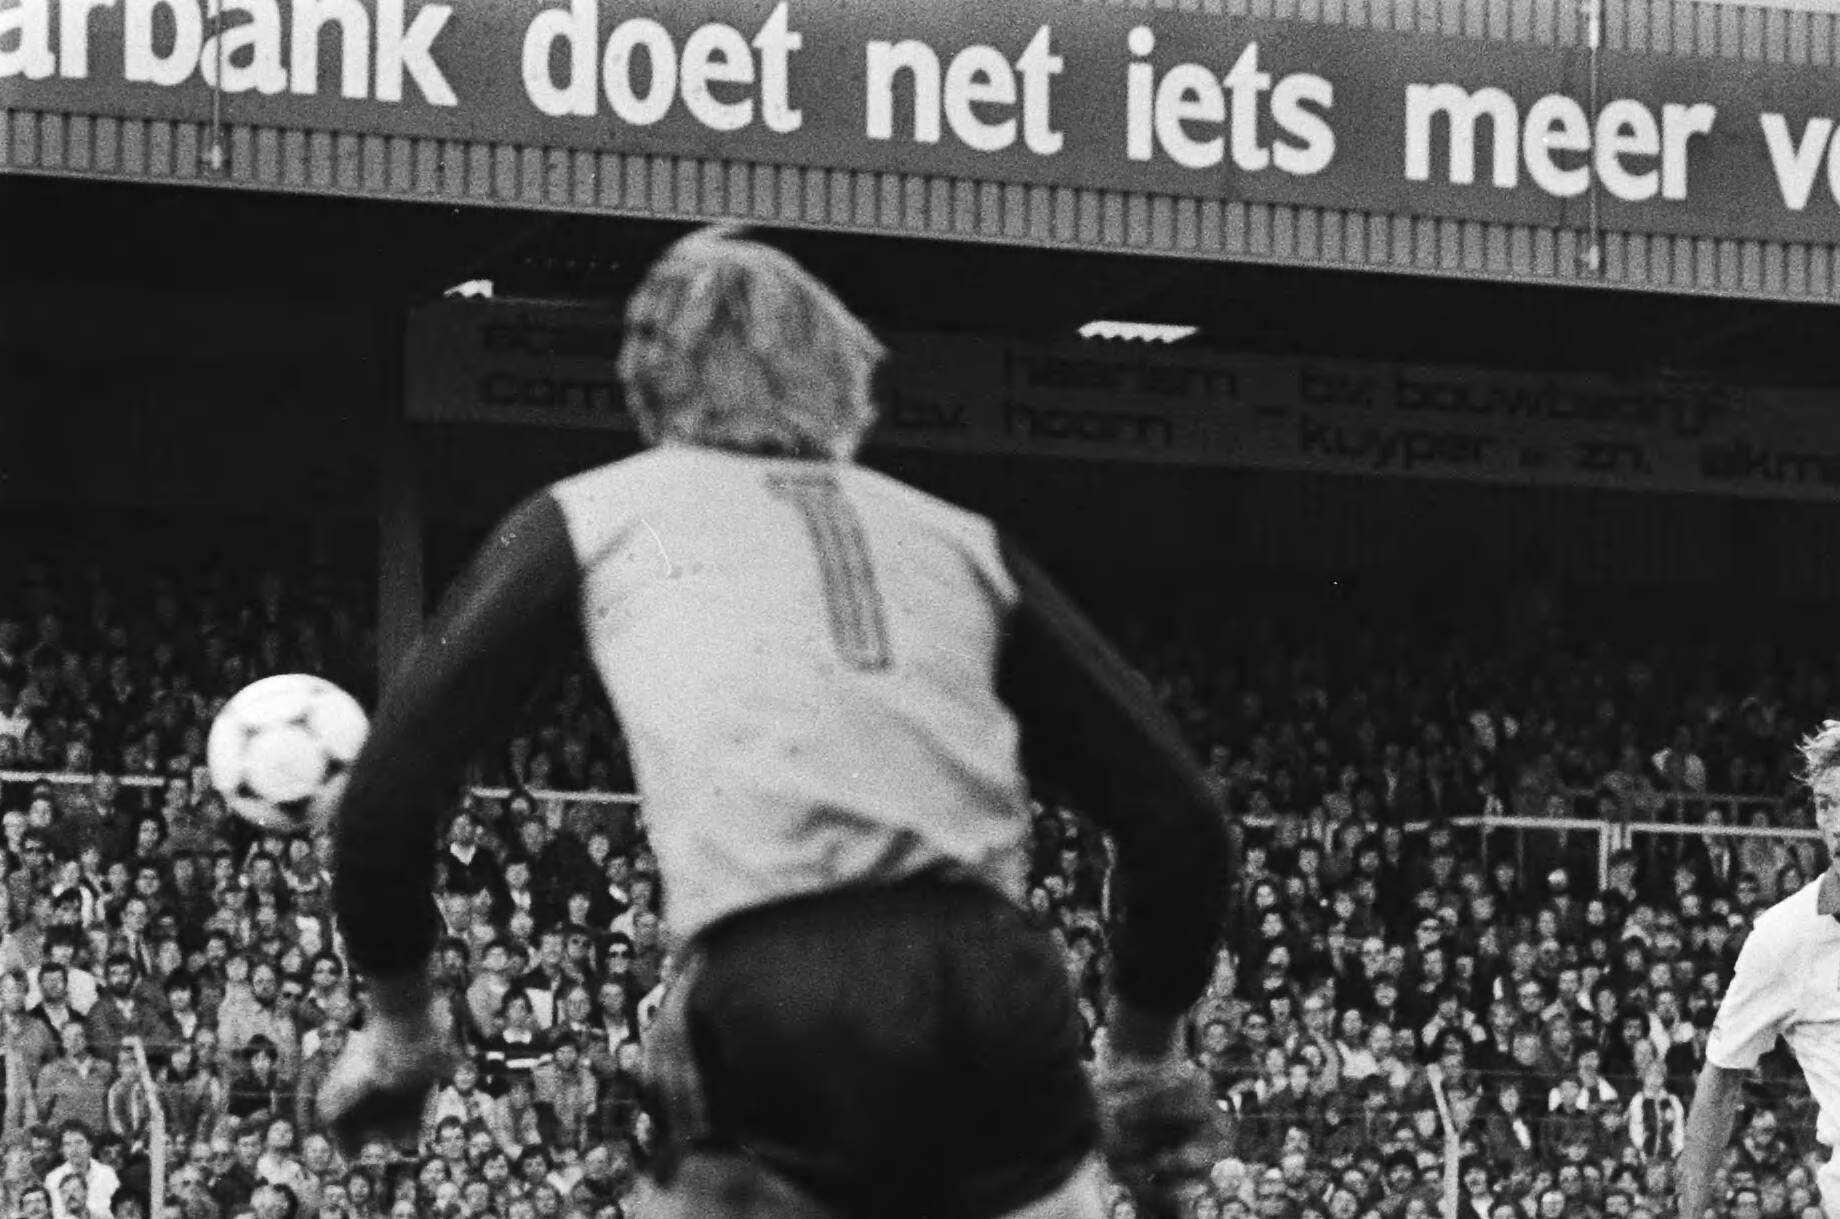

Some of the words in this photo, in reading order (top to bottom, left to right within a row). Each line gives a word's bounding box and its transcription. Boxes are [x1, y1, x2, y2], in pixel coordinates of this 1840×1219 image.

[521, 0, 803, 133] doet
[866, 25, 1064, 156] net
[1126, 26, 1337, 176] iets
[1405, 82, 1716, 202] meer
